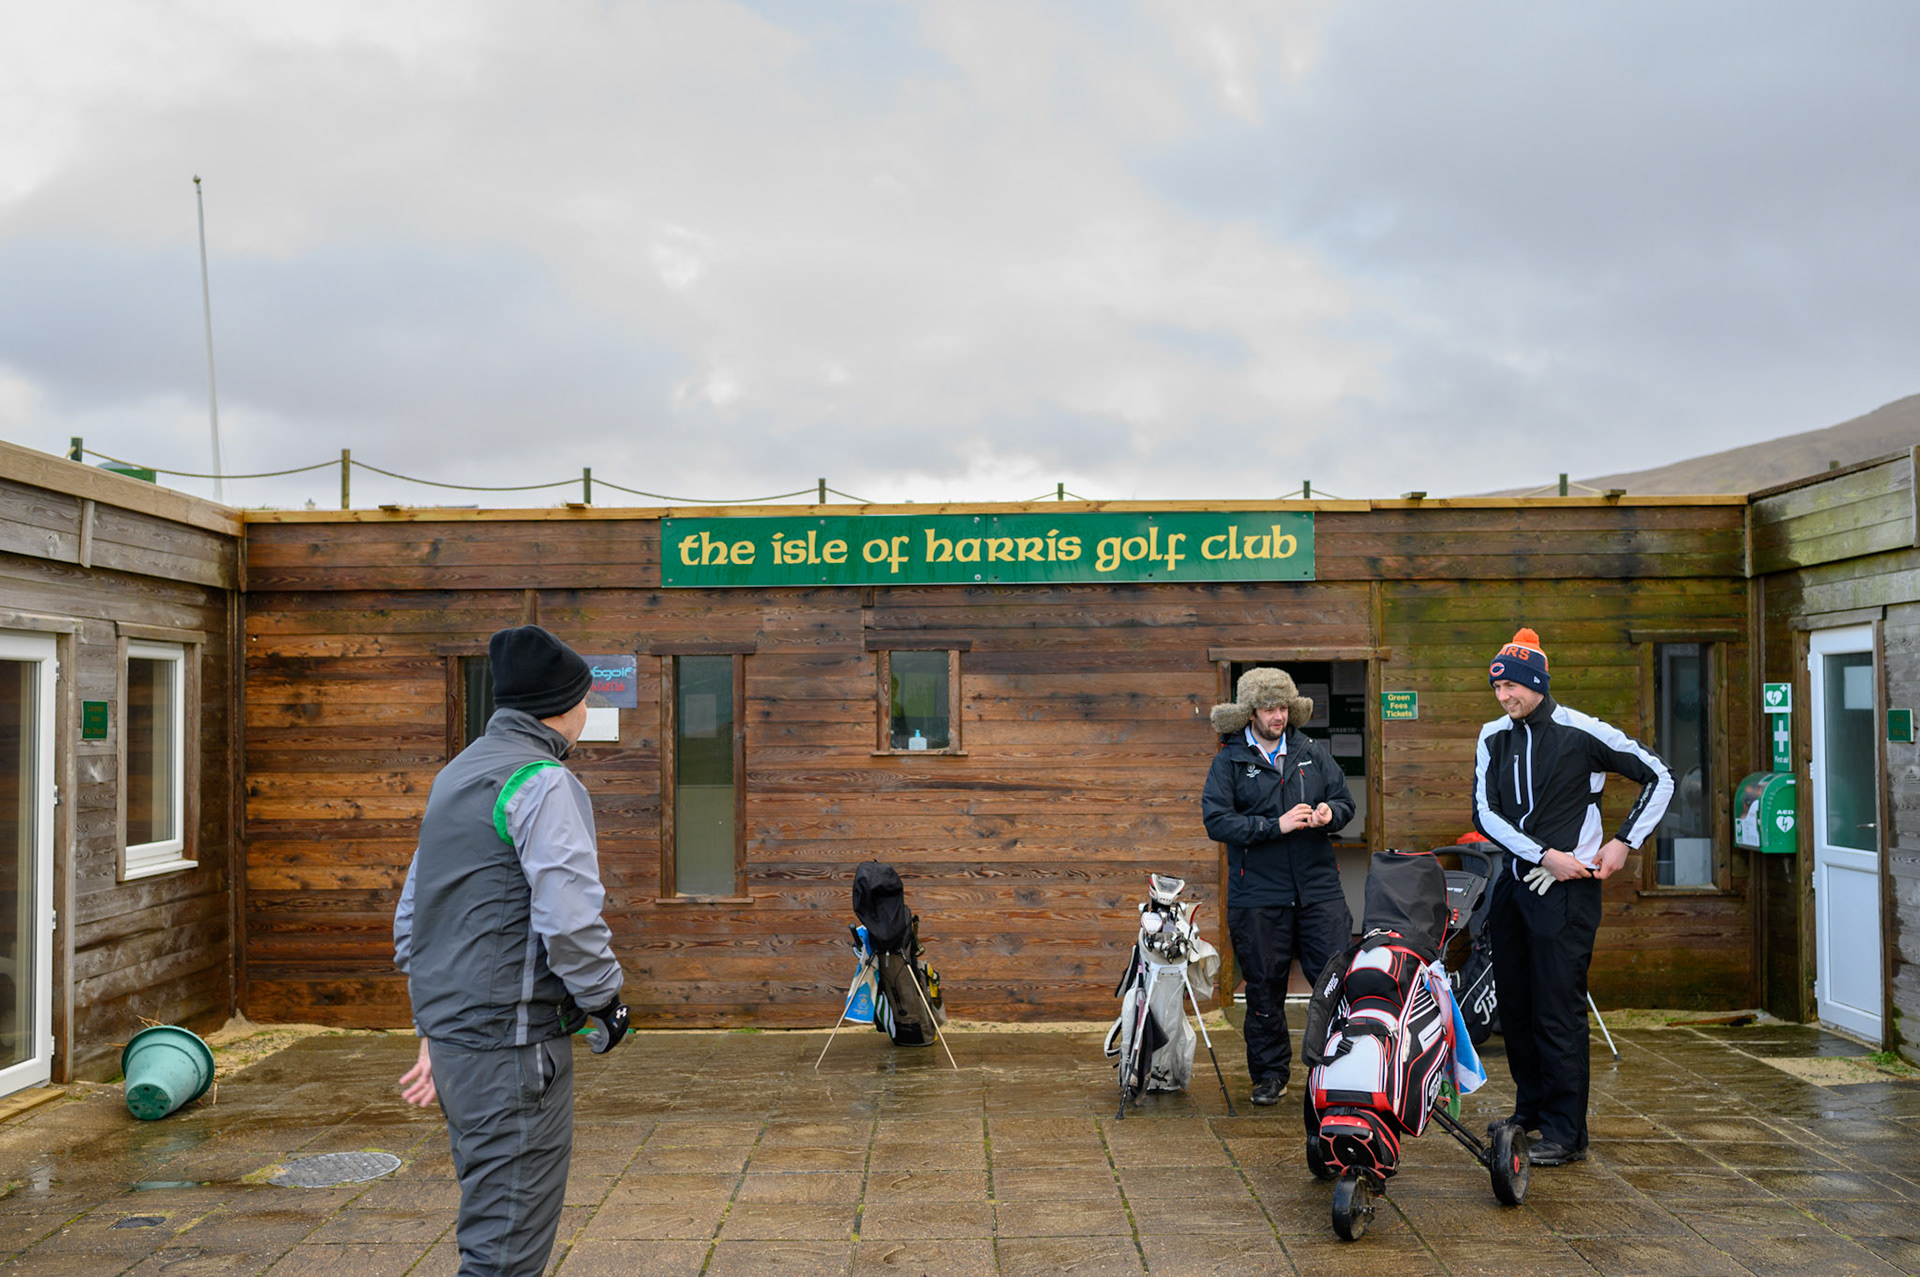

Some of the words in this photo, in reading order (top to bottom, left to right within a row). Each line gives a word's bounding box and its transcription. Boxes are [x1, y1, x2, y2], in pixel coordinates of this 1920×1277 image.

[678, 531, 756, 565] the
[771, 530, 848, 565] isle
[862, 535, 909, 573] of
[1095, 526, 1186, 572] golf
[1200, 524, 1297, 561] club
[1498, 646, 1531, 661] ARS
[1387, 693, 1411, 701] Green
[1389, 701, 1409, 710] Fees
[1385, 710, 1413, 718] Tickets
[1774, 755, 1783, 764] First
